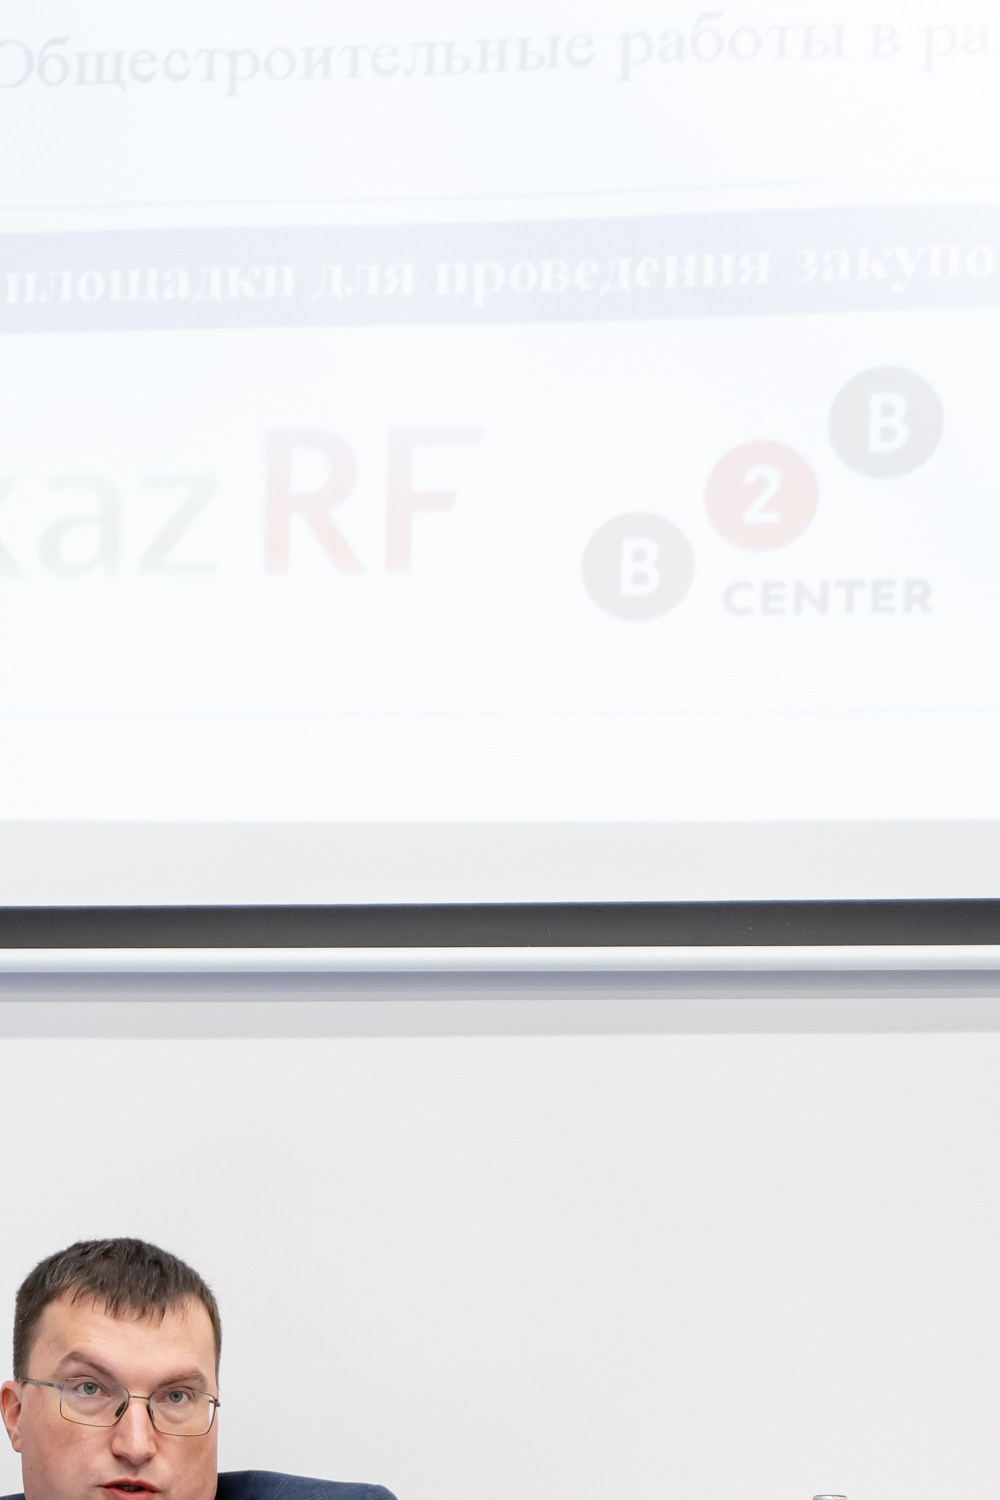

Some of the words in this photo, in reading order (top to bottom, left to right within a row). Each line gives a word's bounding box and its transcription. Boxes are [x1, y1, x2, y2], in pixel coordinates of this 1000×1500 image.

[616, 11, 847, 82] работы
[867, 22, 901, 59] в
[919, 21, 1000, 75] ра
[4, 263, 297, 305] площадки
[312, 262, 415, 303] для
[435, 248, 771, 308] проведения
[791, 244, 997, 293] закупо
[263, 426, 486, 575] RF
[721, 577, 934, 618] CENTER
